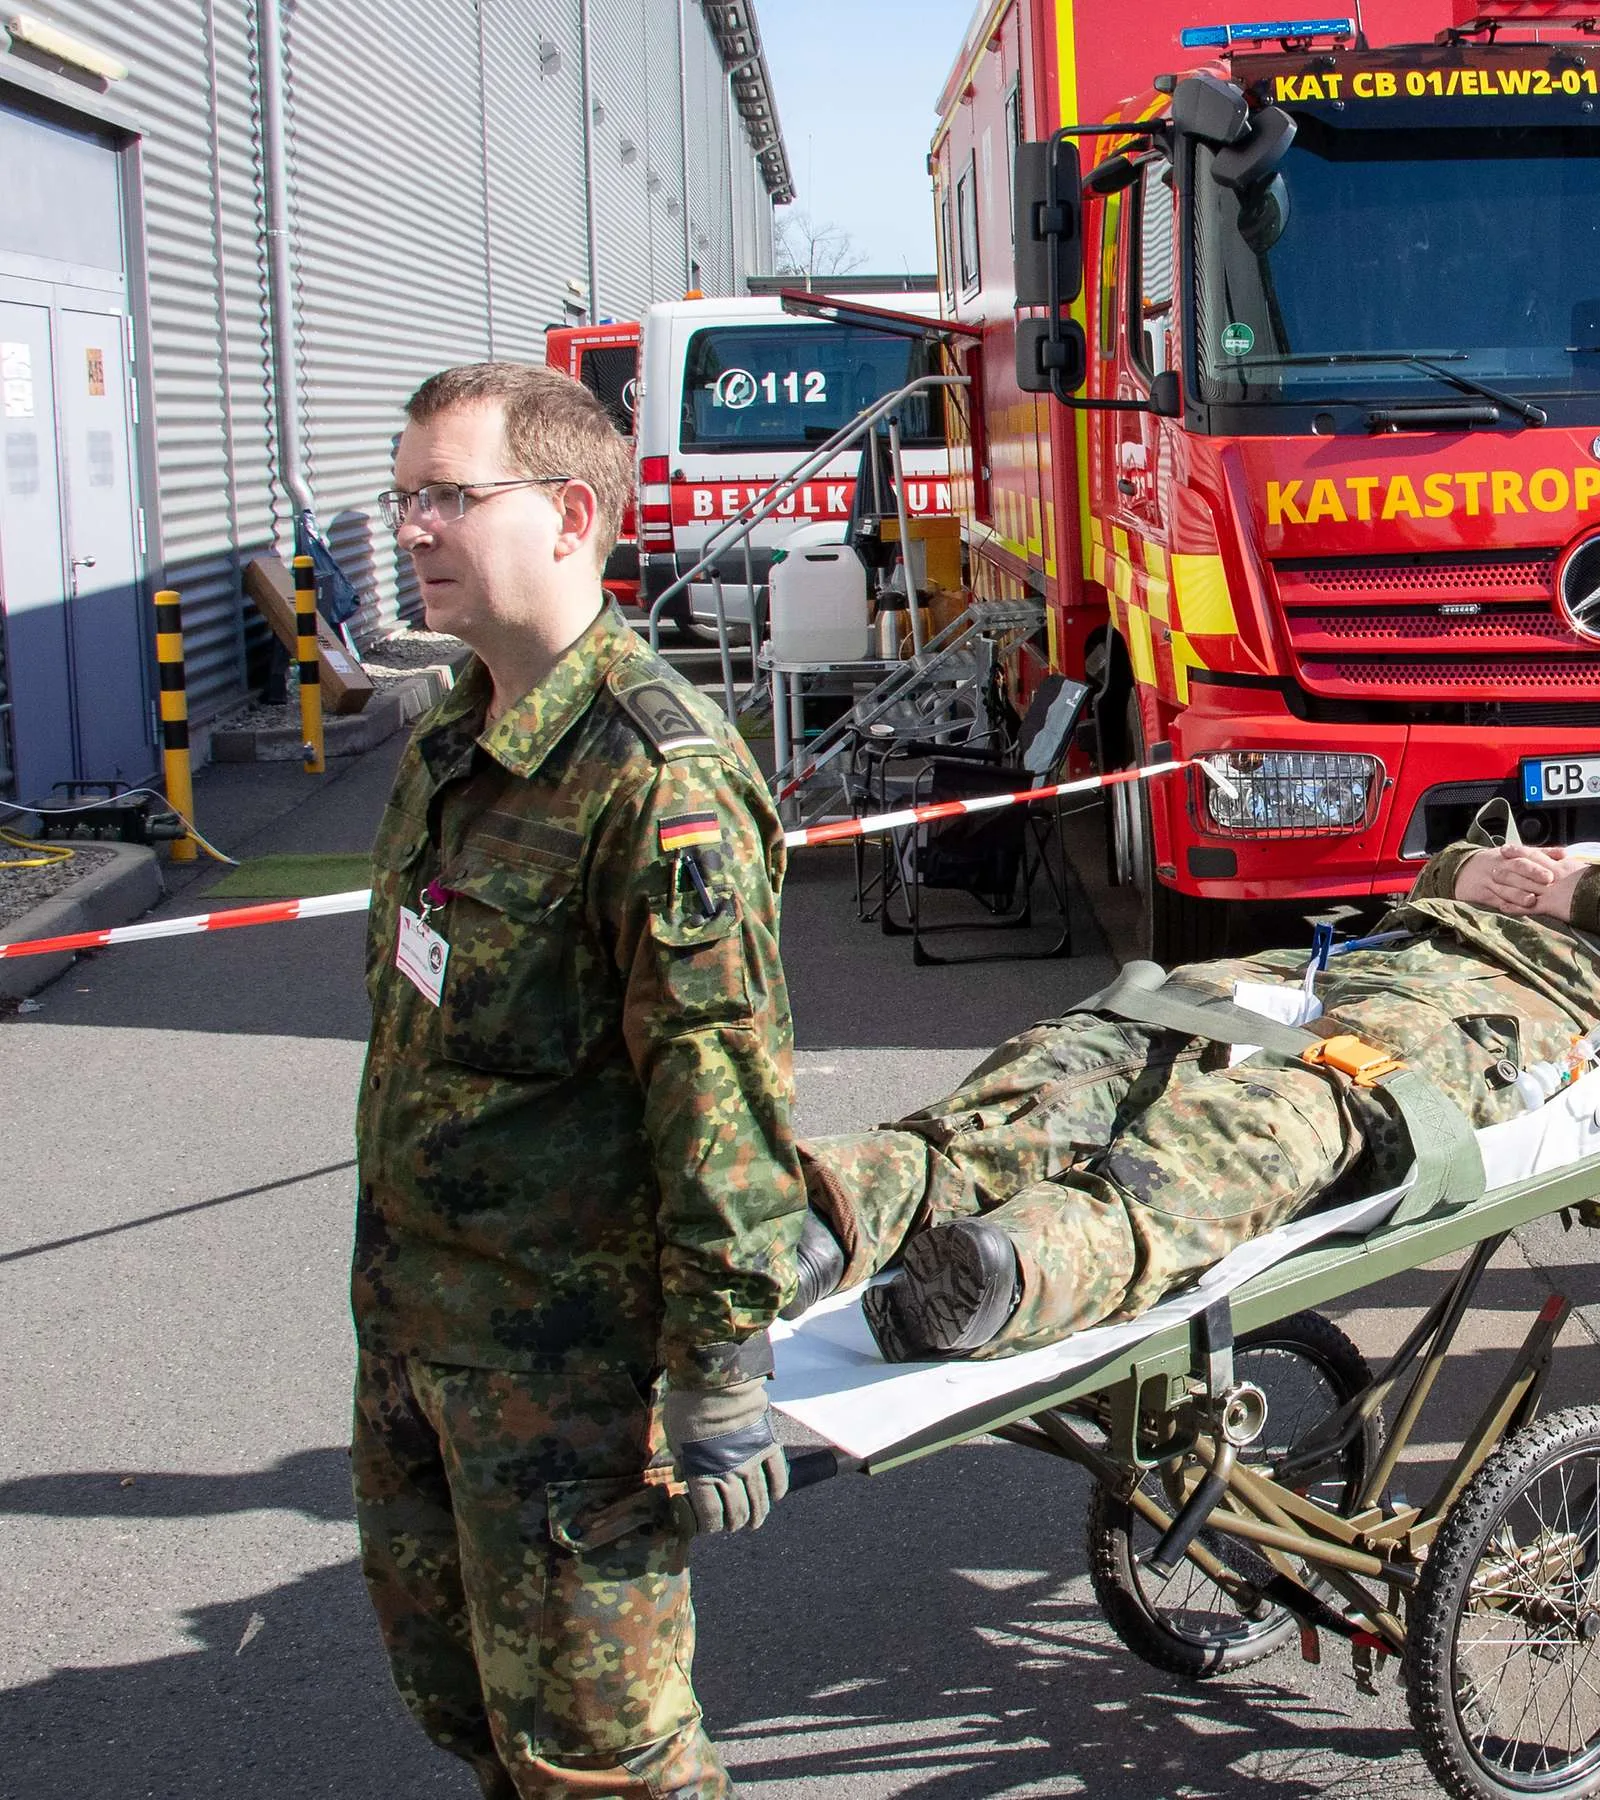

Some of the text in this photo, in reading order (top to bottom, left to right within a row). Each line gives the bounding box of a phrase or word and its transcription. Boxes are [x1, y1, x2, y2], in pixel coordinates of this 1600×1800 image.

[1275, 69, 1598, 102] KAT CB 01/ELW2-01
[761, 371, 827, 404] 112
[1530, 786, 1538, 796] D
[1544, 764, 1584, 796] CB
